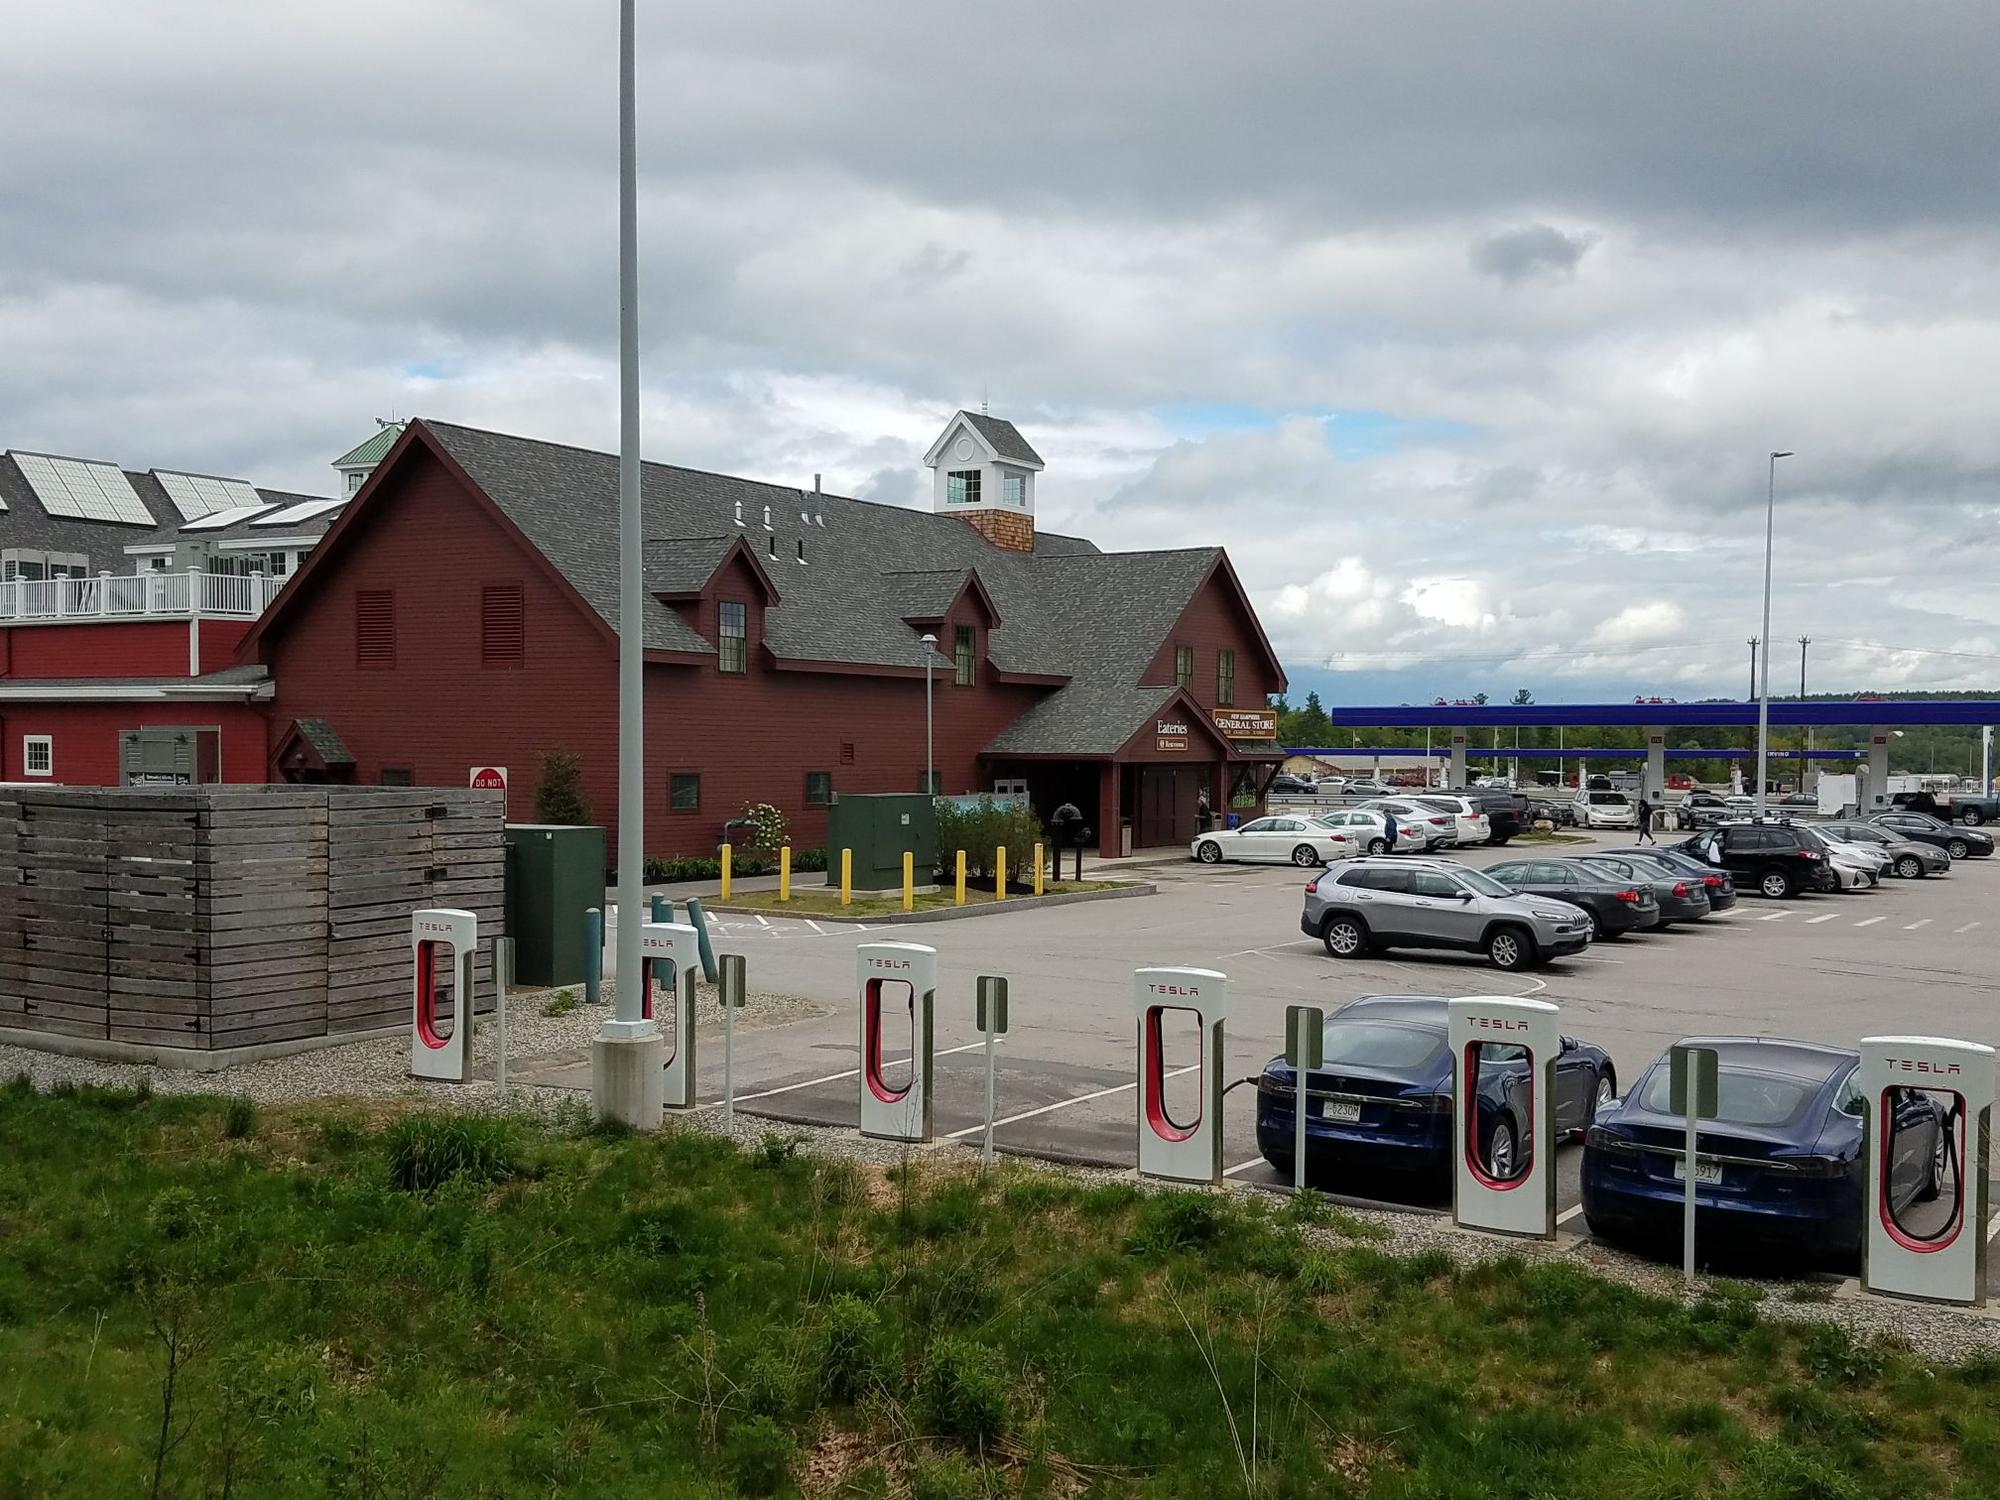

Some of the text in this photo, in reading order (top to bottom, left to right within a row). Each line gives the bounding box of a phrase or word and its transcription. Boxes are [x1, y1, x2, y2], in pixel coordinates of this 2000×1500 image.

[1157, 719, 1188, 734] Eateries
[1215, 718, 1274, 730] GENERAL STORE
[475, 779, 501, 787] DO NOT
[418, 922, 452, 932] TESLA
[643, 938, 674, 948] ESLA
[867, 958, 910, 969] TESLA
[1148, 984, 1199, 996] TESLA
[1467, 1016, 1528, 1031] TESLA
[1885, 1058, 1960, 1075] TESLA
